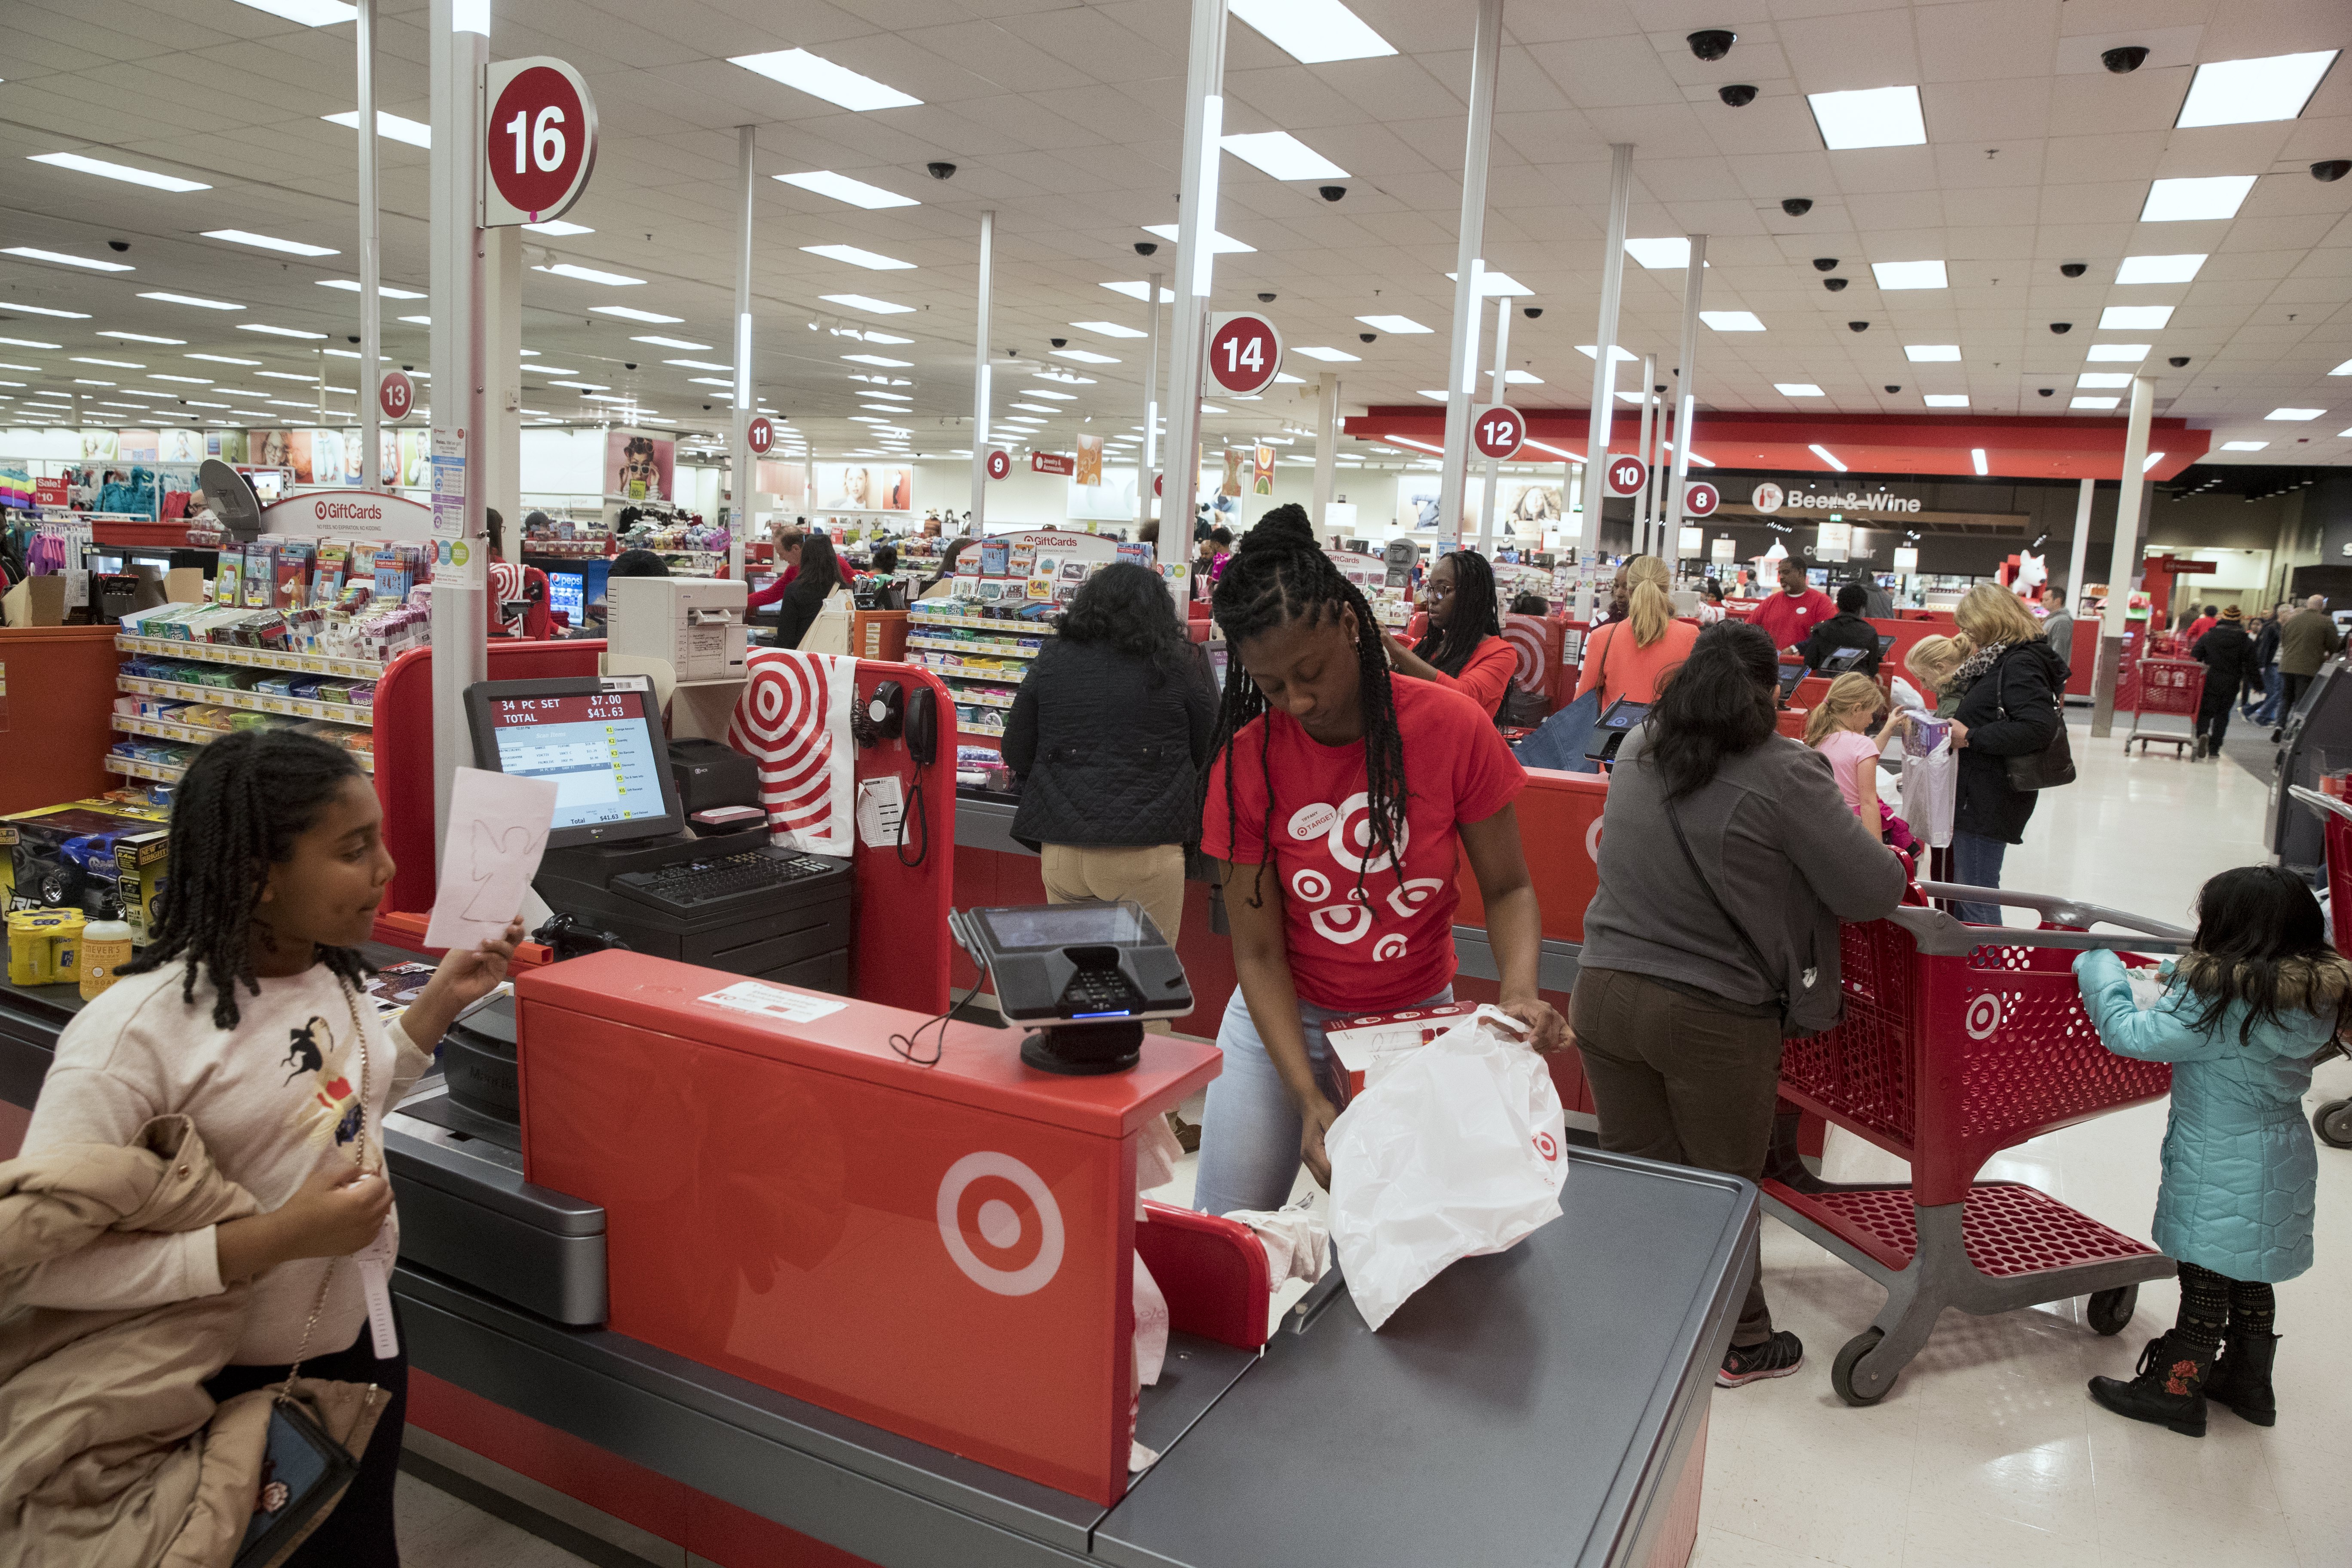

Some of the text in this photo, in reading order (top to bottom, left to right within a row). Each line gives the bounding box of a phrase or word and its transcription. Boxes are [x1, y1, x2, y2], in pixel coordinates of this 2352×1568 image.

[507, 105, 566, 174] 16
[1223, 337, 1264, 372] 14
[386, 385, 405, 406] 13
[753, 426, 767, 444] 11
[1483, 421, 1513, 446] 12
[994, 457, 1003, 472] 9
[37, 478, 61, 488] Sale!
[1616, 466, 1638, 486] 10
[38, 493, 53, 502] $10
[1696, 492, 1707, 507] 8
[1788, 490, 1922, 513] Beer & Wine
[328, 503, 382, 520] GiftCards
[1035, 536, 1077, 546] GiftCards
[1328, 554, 1360, 564] GiftCards
[561, 575, 582, 586] pepsi
[502, 695, 622, 710] 34 PC SET $7.00
[503, 707, 624, 723] TOTAL $41.63
[1302, 811, 1318, 822] TIFFANY
[1307, 812, 1334, 830] TARGET
[141, 845, 156, 857] NEW
[141, 848, 167, 864] BRIGHT
[86, 945, 120, 954] MEYER'S
